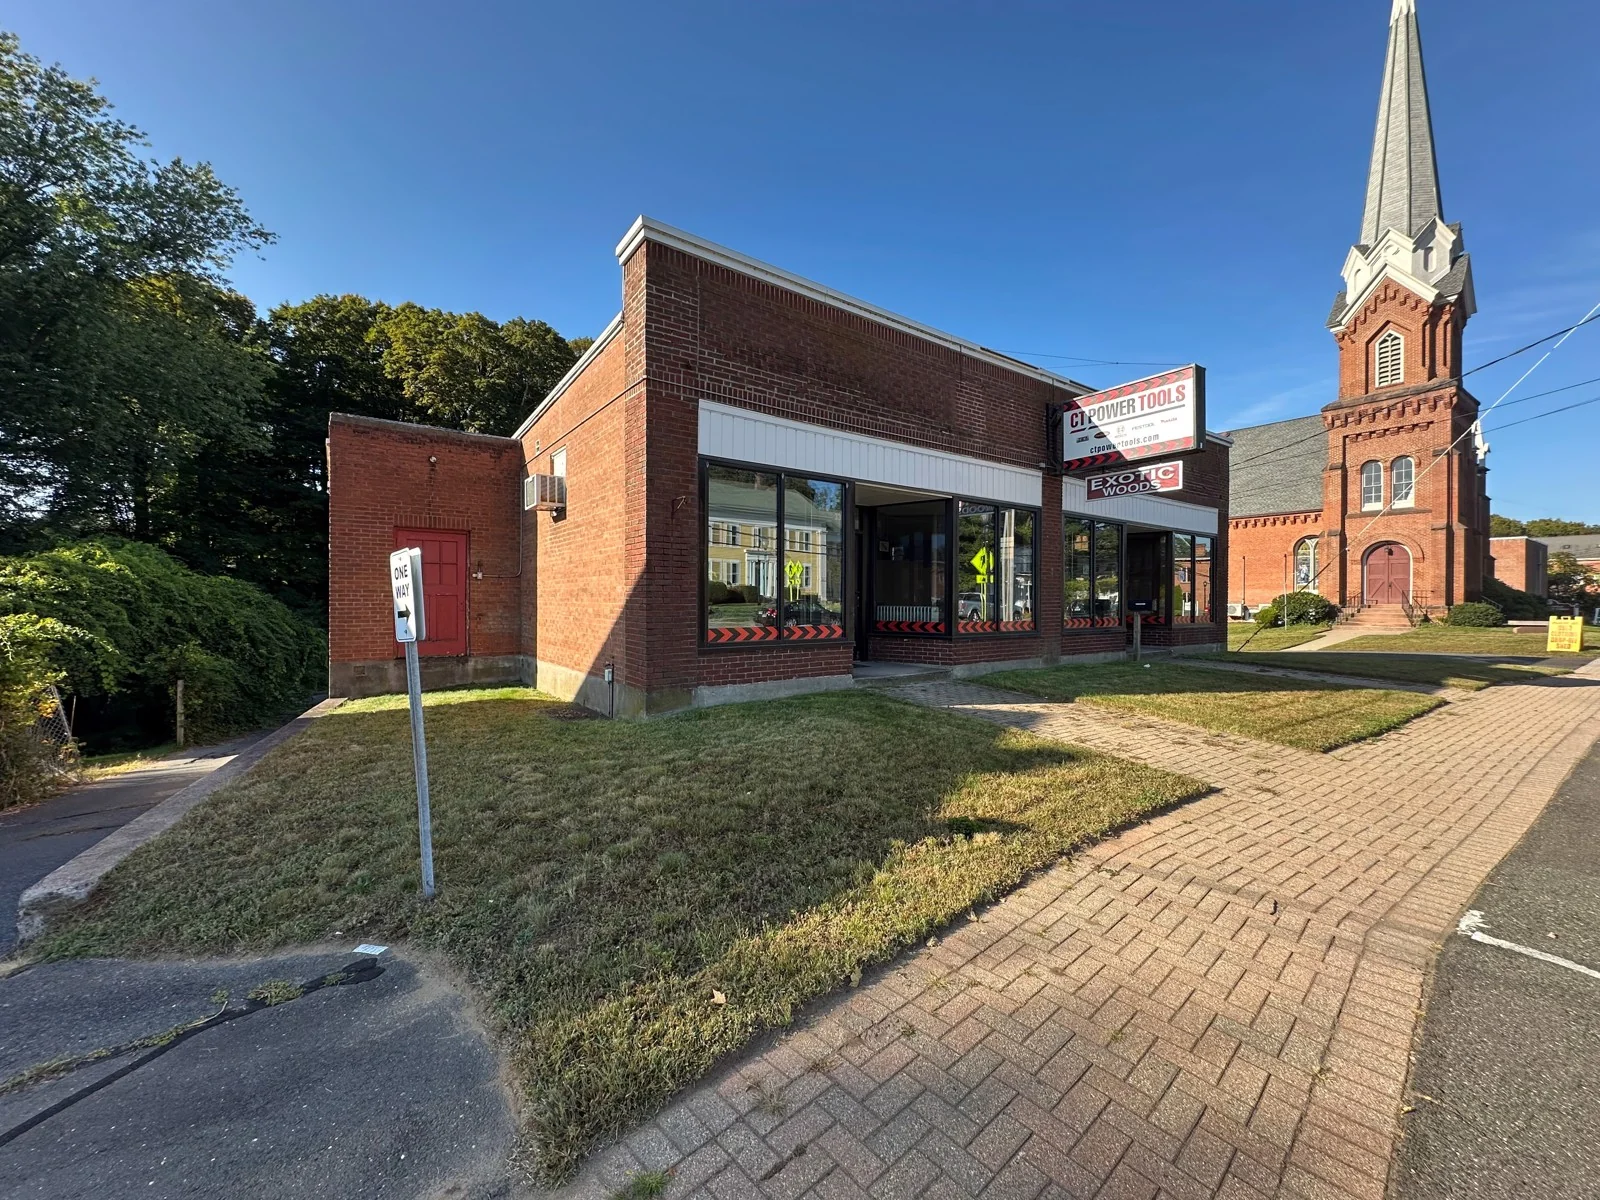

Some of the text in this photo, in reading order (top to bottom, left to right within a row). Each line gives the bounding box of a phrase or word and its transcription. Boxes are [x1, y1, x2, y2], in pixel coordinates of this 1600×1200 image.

[1070, 384, 1186, 428] CT POWER TOOLS
[1089, 433, 1160, 454] ctpowertools.com
[1091, 466, 1175, 491] EXOTIC
[1103, 479, 1162, 497] WOODS
[394, 564, 408, 581] ONE
[395, 583, 410, 600] WAY
